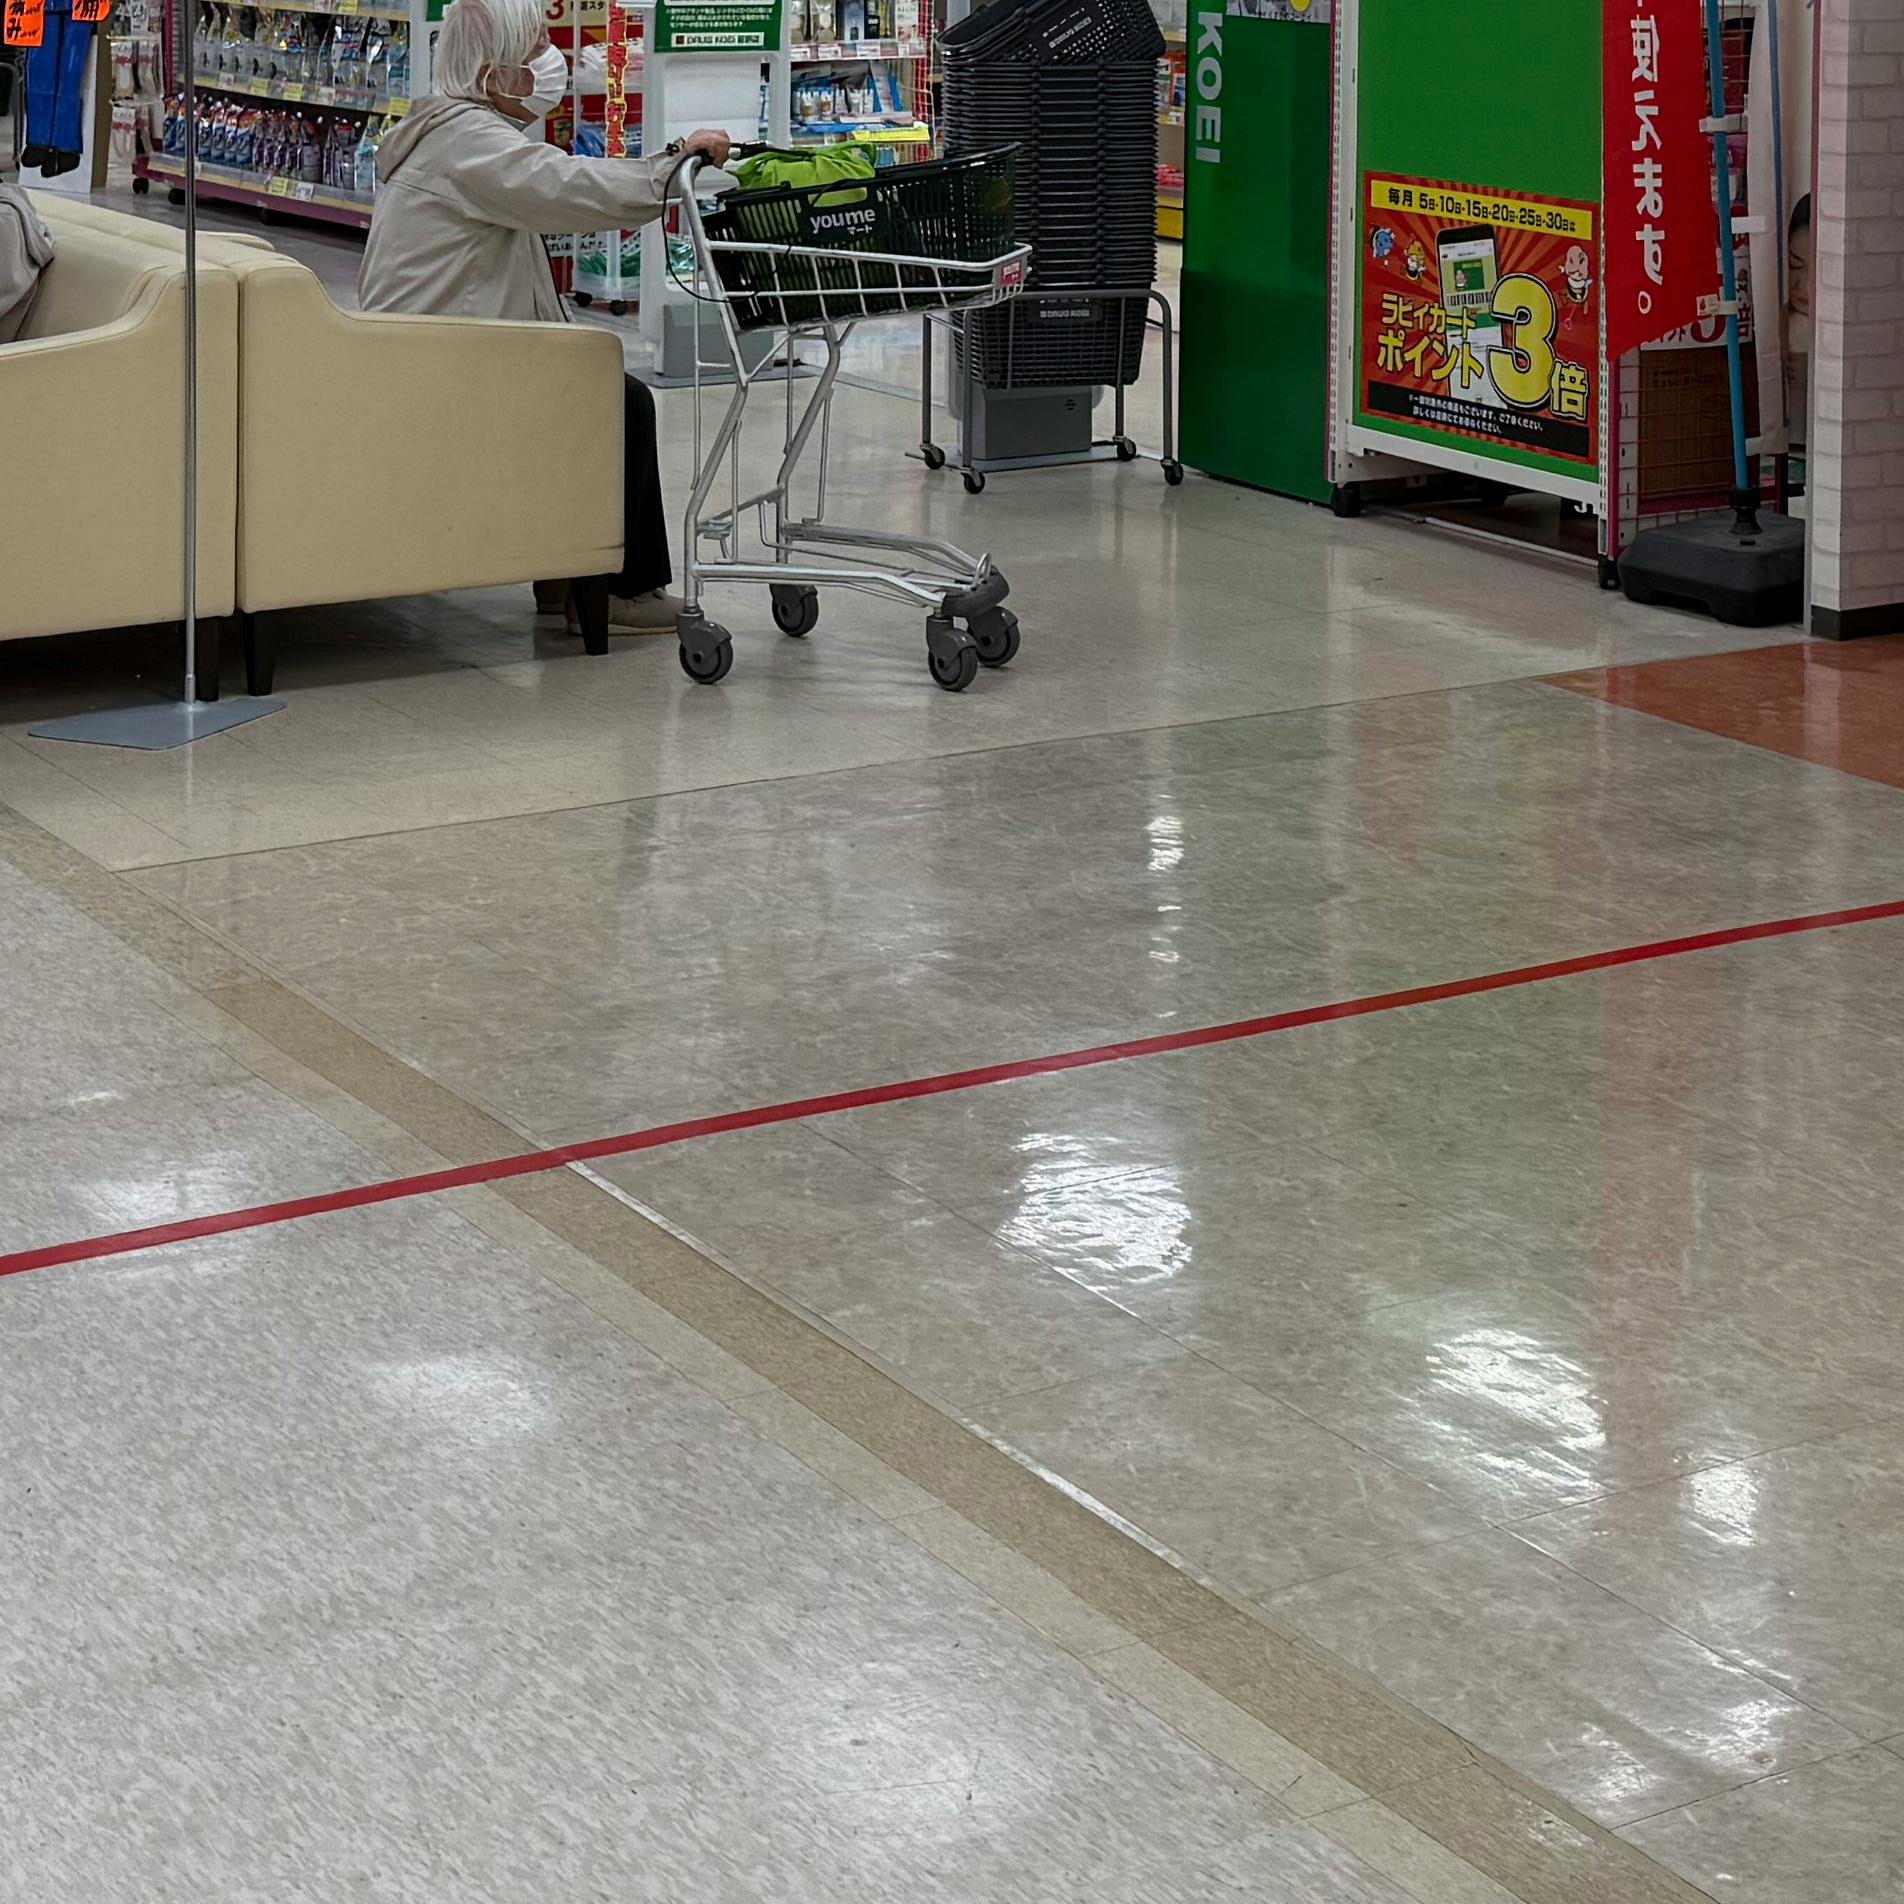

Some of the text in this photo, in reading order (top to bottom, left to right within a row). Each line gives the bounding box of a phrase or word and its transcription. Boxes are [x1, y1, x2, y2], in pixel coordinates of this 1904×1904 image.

[1195, 11, 1225, 164] KOEI
[810, 208, 876, 234] youme
[847, 224, 873, 236] マート
[1377, 330, 1485, 389] ポイント
